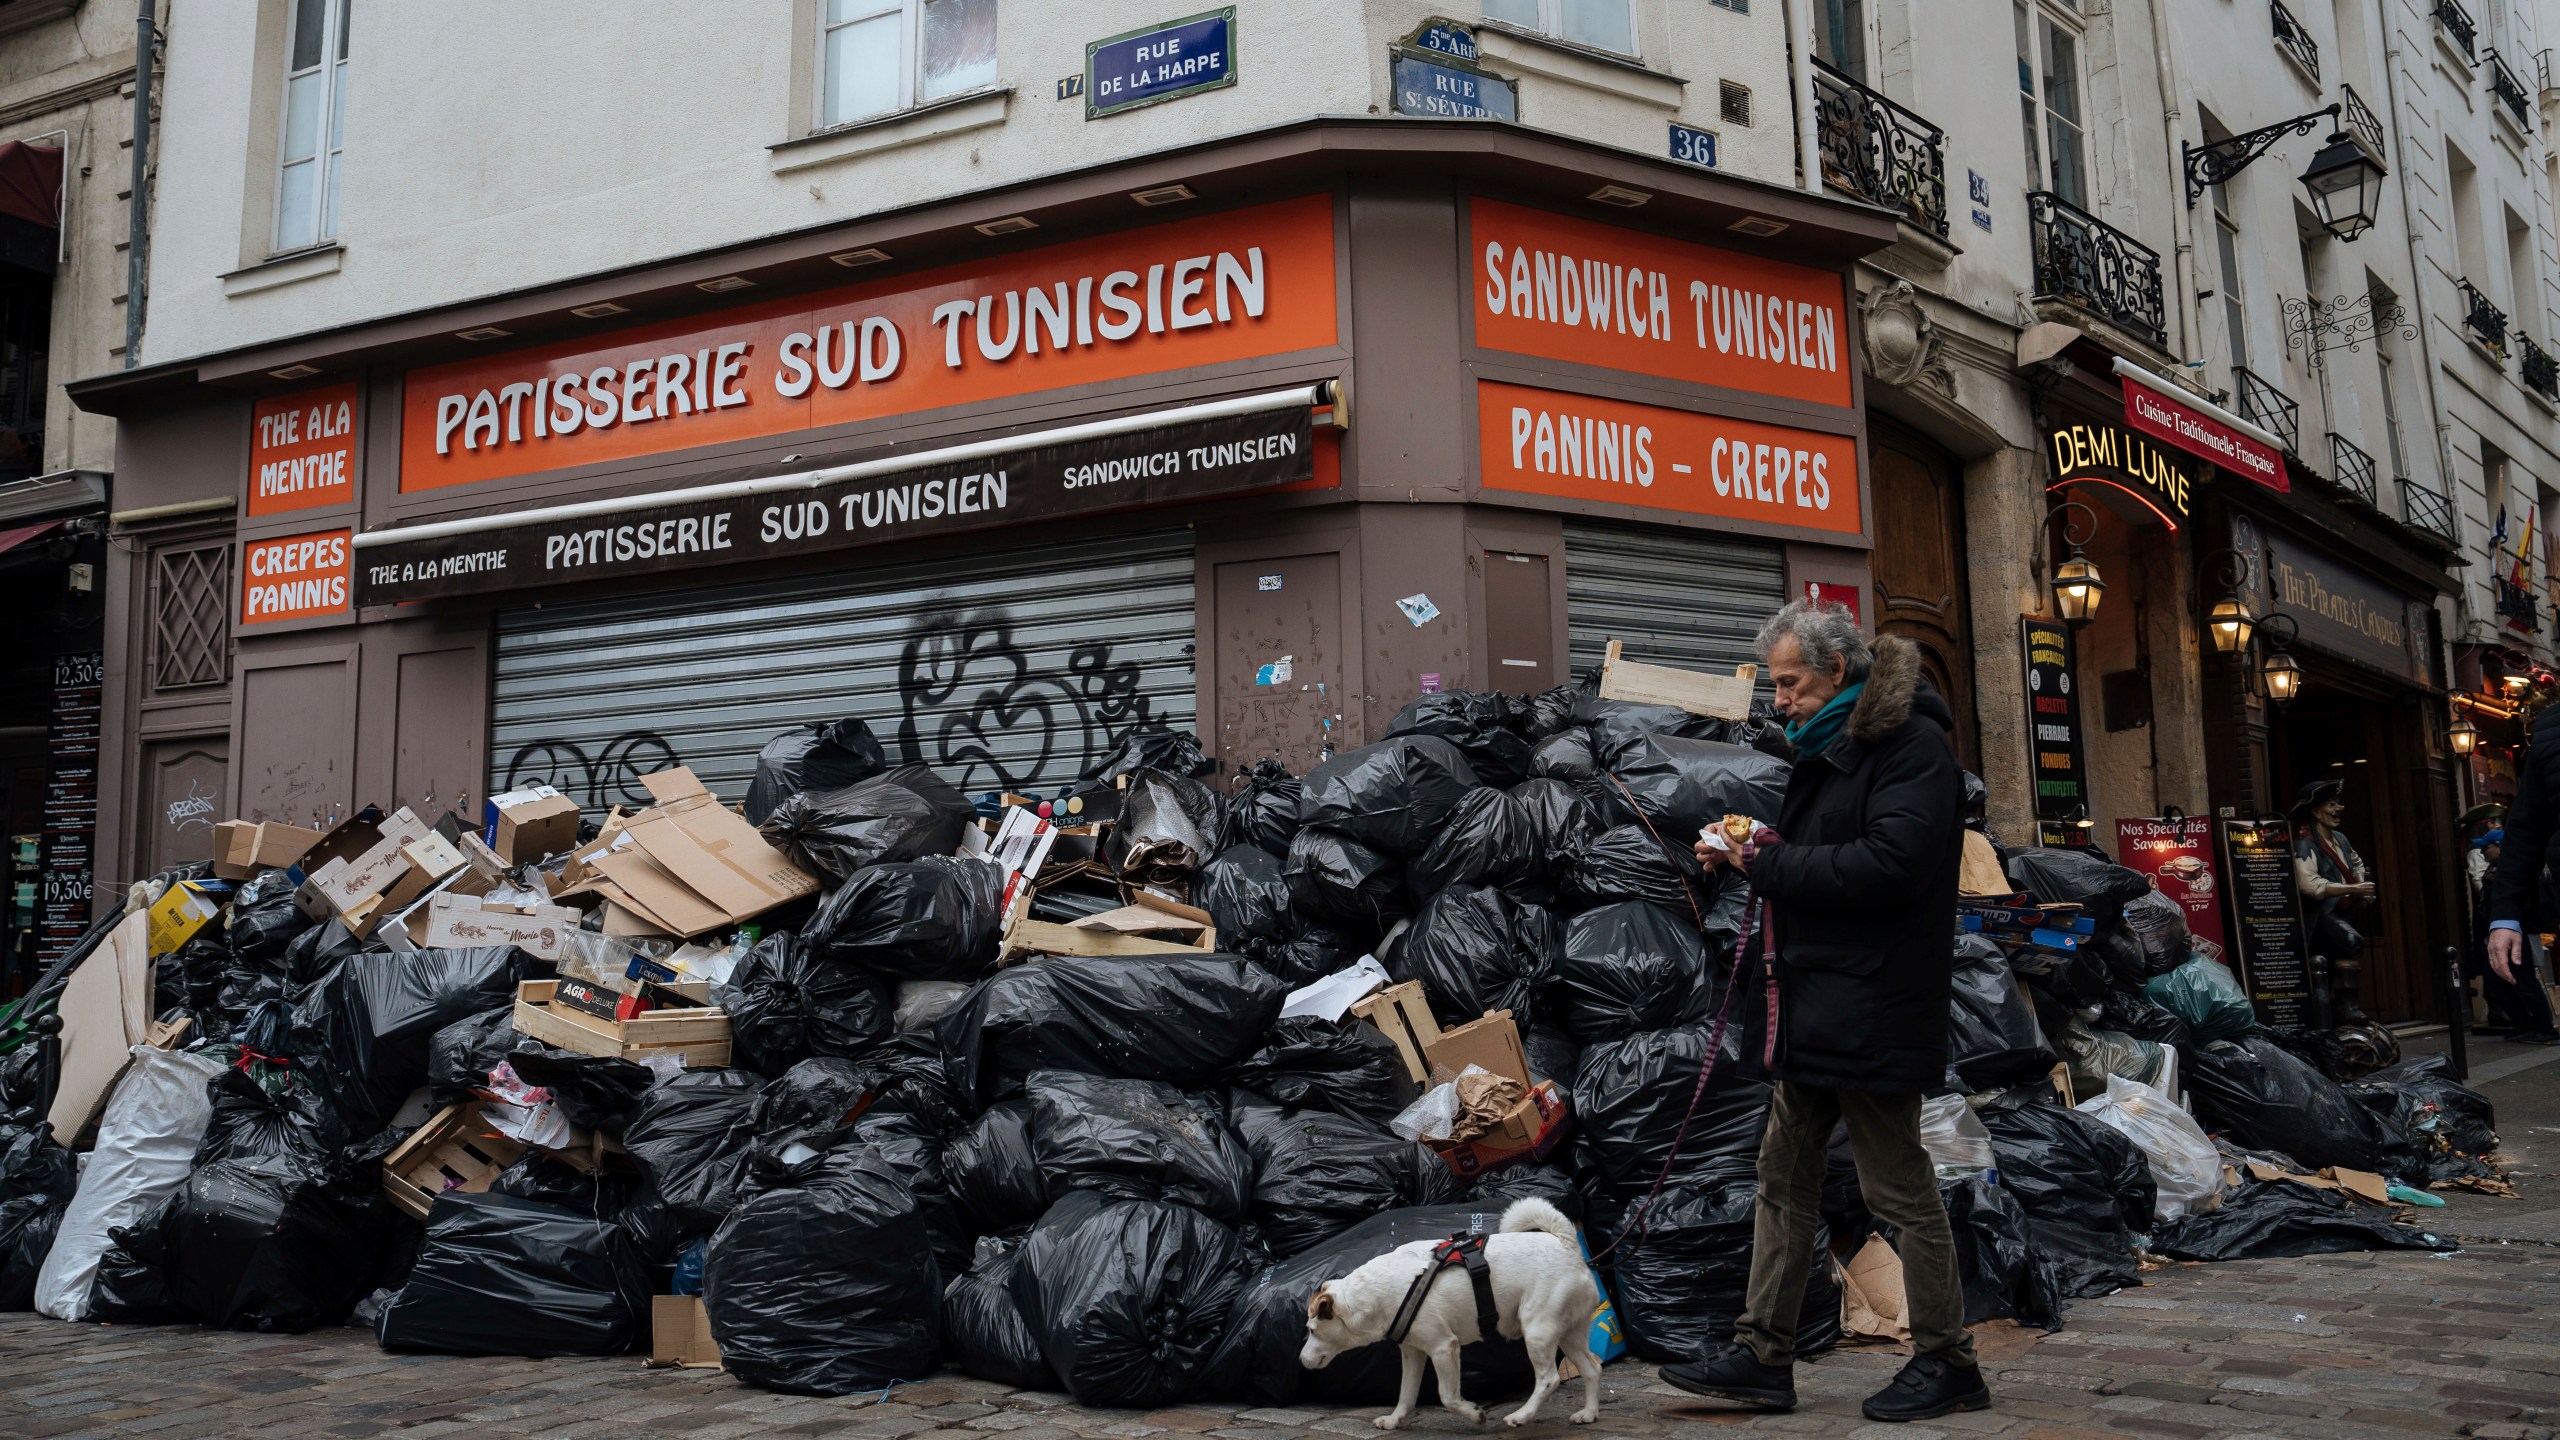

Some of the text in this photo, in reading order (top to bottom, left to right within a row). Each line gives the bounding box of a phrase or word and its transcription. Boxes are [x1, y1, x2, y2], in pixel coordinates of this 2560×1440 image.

[1136, 38, 1181, 63] RUE
[1059, 77, 1082, 98] 17
[1100, 52, 1221, 96] DE LA HARPE
[1435, 74, 1475, 98] RUE
[1678, 130, 1709, 165] 36
[1972, 175, 1988, 205] 34
[1486, 242, 1836, 373] SANDWICH TUNISIEN
[434, 247, 1265, 455] PATISSERIE SUD TUNISIEN
[260, 417, 299, 448] THE
[2136, 395, 2275, 475] Cuisine Traditionnelle Française
[260, 450, 347, 497] MENTHE
[1063, 434, 1296, 489] SANDWICH TUNISIEN
[1512, 408, 1655, 488] PANINIS
[1711, 437, 1830, 511] CREPES
[2054, 425, 2189, 517] DEMI LUNE
[545, 471, 1007, 570] PATISSERIE SUD TUNISIEN
[250, 538, 345, 577] CREPES
[370, 550, 507, 585] THE A LA MENTHE
[248, 575, 346, 616] PANINIS
[2280, 562, 2308, 608] THE
[2359, 599, 2401, 647] CANDIES
[2030, 629, 2065, 650] SPÉCIALITÉS
[2032, 650, 2065, 668] FRANÇAISES
[2036, 697, 2068, 714] RACLETTE
[2038, 723, 2070, 742] PIERRADE
[2041, 752, 2071, 770] FONDUES
[2038, 780, 2078, 798] TARTIFLETTE
[2043, 831, 2060, 844] Menu
[2060, 831, 2066, 845] à
[2121, 823, 2144, 836] Nos
[2229, 831, 2250, 842] Menu
[592, 994, 615, 1010] DELUXE
